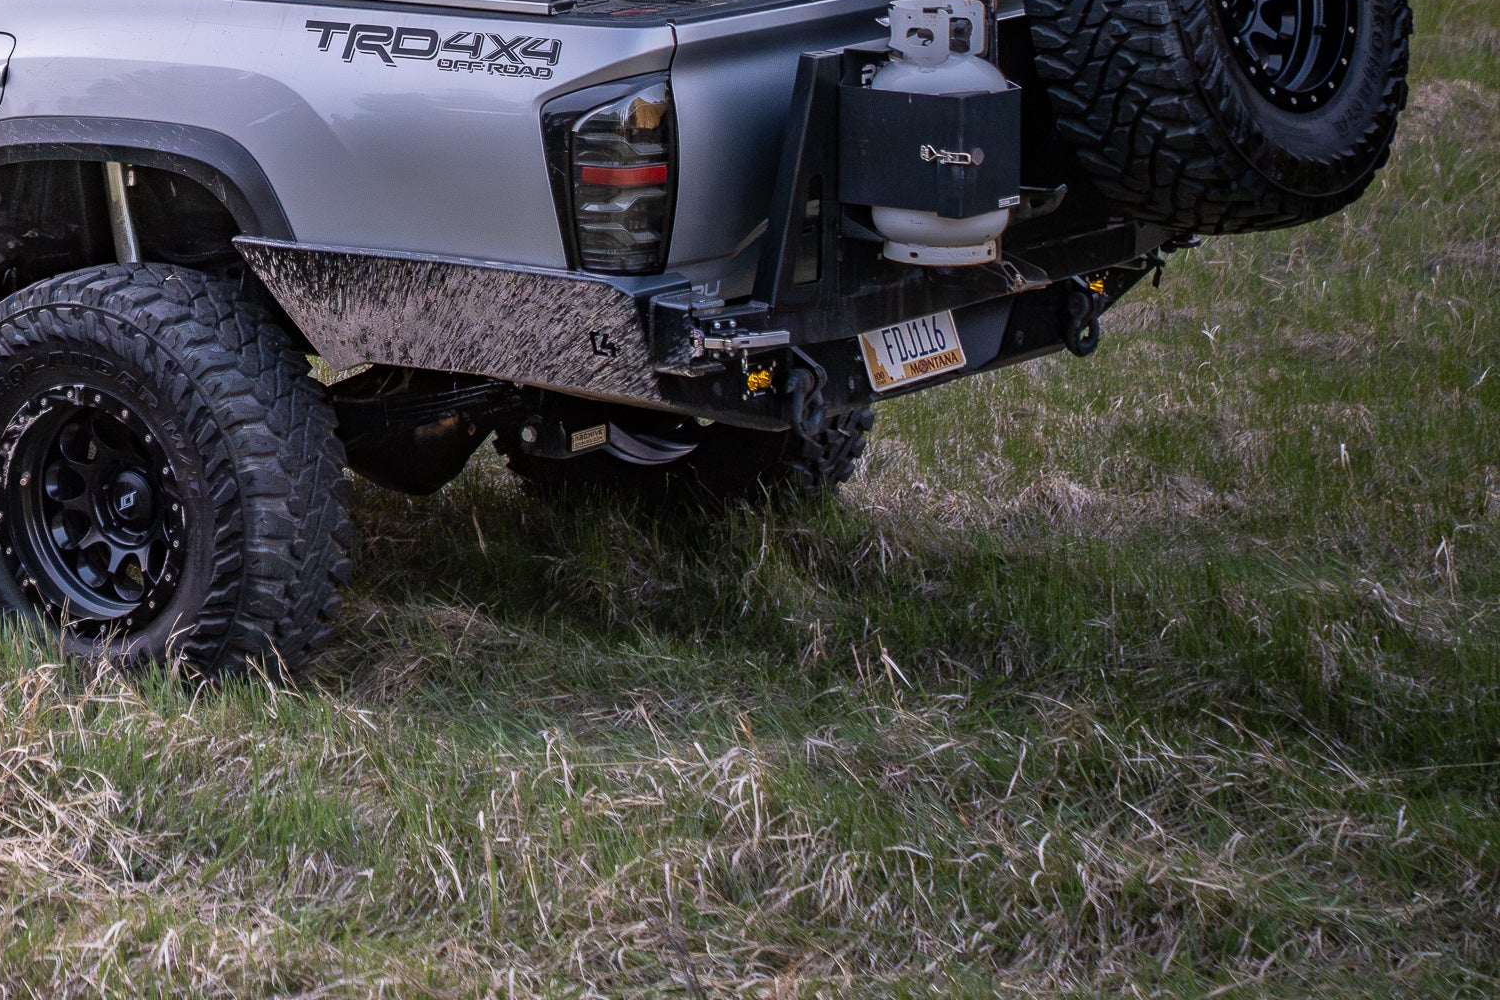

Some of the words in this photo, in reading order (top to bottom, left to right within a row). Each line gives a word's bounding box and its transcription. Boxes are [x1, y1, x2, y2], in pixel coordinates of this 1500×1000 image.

[305, 20, 441, 67] TRD
[437, 58, 485, 74] OFF
[486, 62, 554, 81] ROAD
[881, 315, 946, 366] FDJ116
[909, 351, 959, 376] MONTANA
